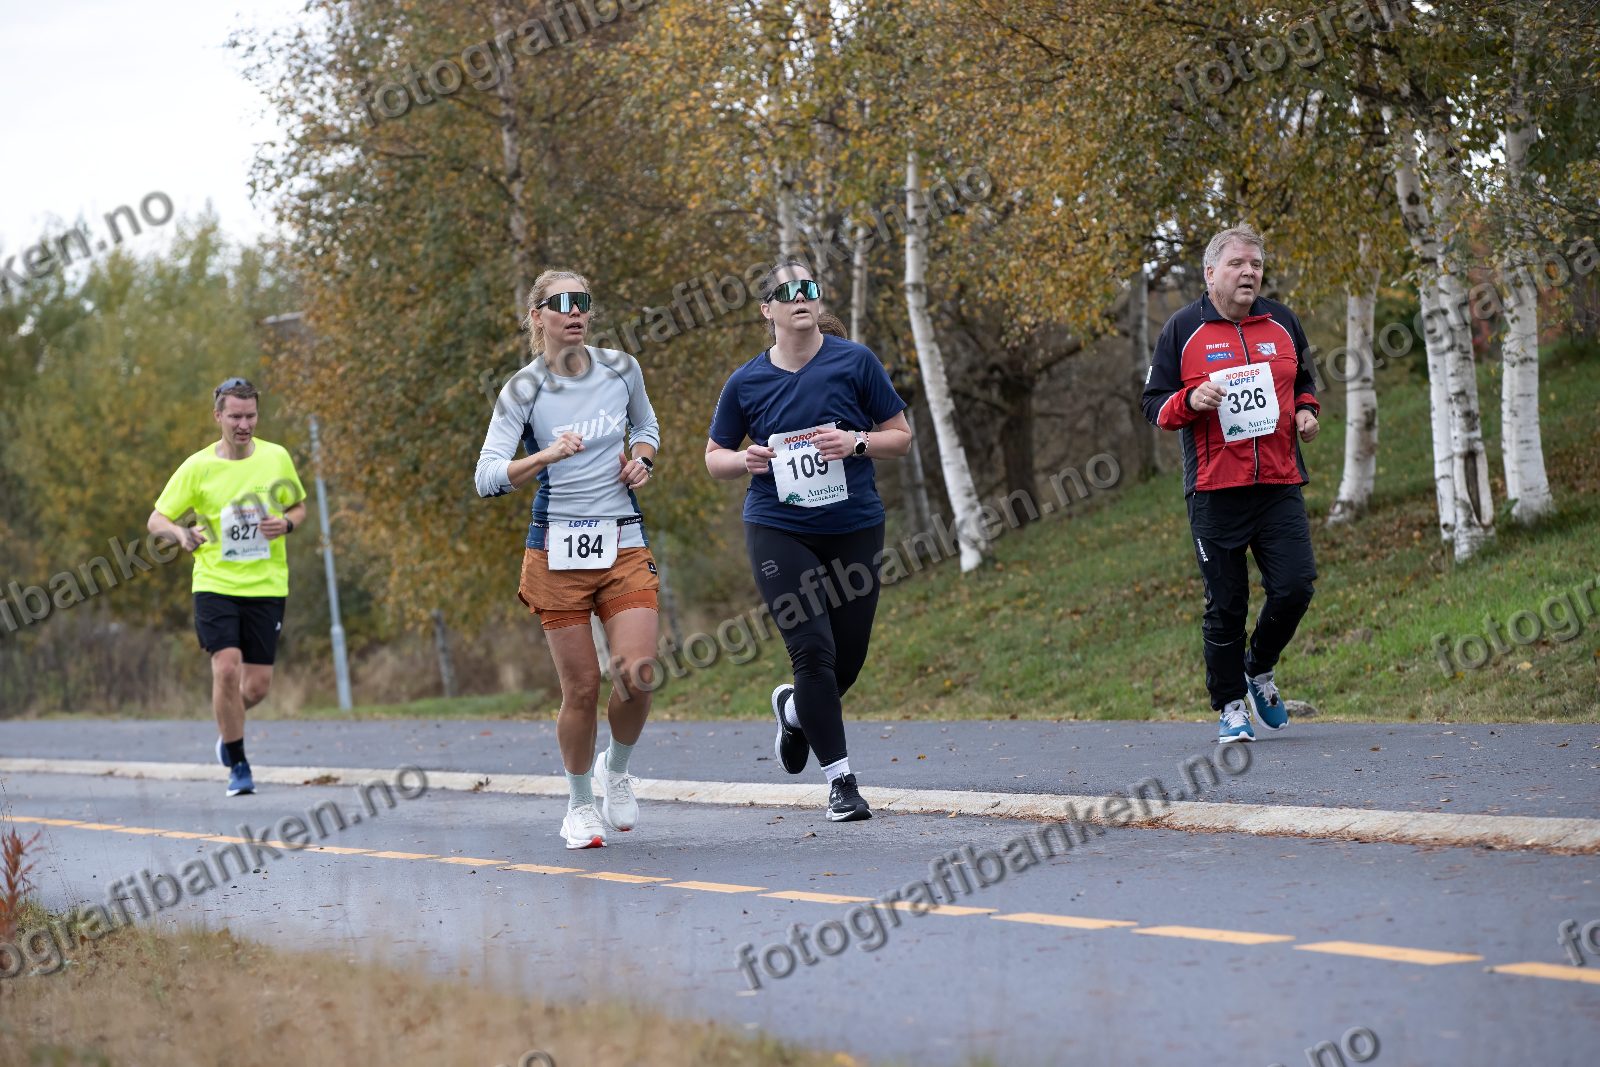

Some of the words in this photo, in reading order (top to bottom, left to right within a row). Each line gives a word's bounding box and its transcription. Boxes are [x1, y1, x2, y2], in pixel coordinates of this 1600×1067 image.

[1225, 369, 1260, 380] NORGES
[1229, 375, 1256, 386] LØPET
[1227, 387, 1266, 414] 326
[787, 451, 829, 480] 109
[807, 484, 845, 498] Aurskog
[231, 523, 258, 541] 827
[567, 519, 600, 529] LØPET
[563, 533, 604, 559] 184
